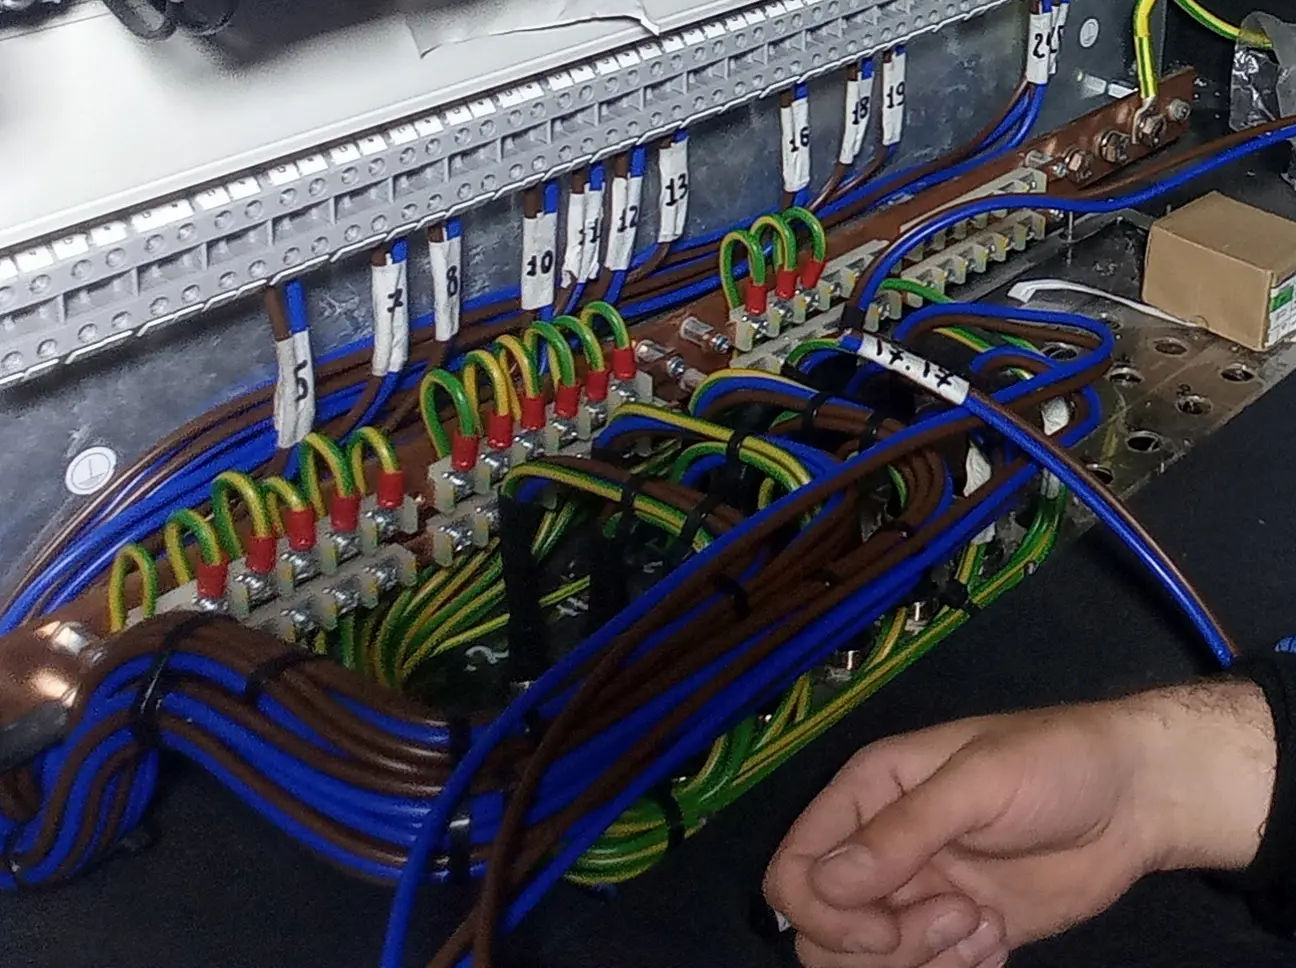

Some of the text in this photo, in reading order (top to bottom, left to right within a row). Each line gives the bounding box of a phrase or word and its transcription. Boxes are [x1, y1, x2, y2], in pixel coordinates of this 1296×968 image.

[851, 96, 870, 125] 18
[789, 127, 809, 152] 16
[665, 173, 688, 207] 13
[617, 205, 639, 233] 12
[526, 249, 554, 277] 10
[446, 265, 458, 298] 8
[293, 359, 309, 403] 5
